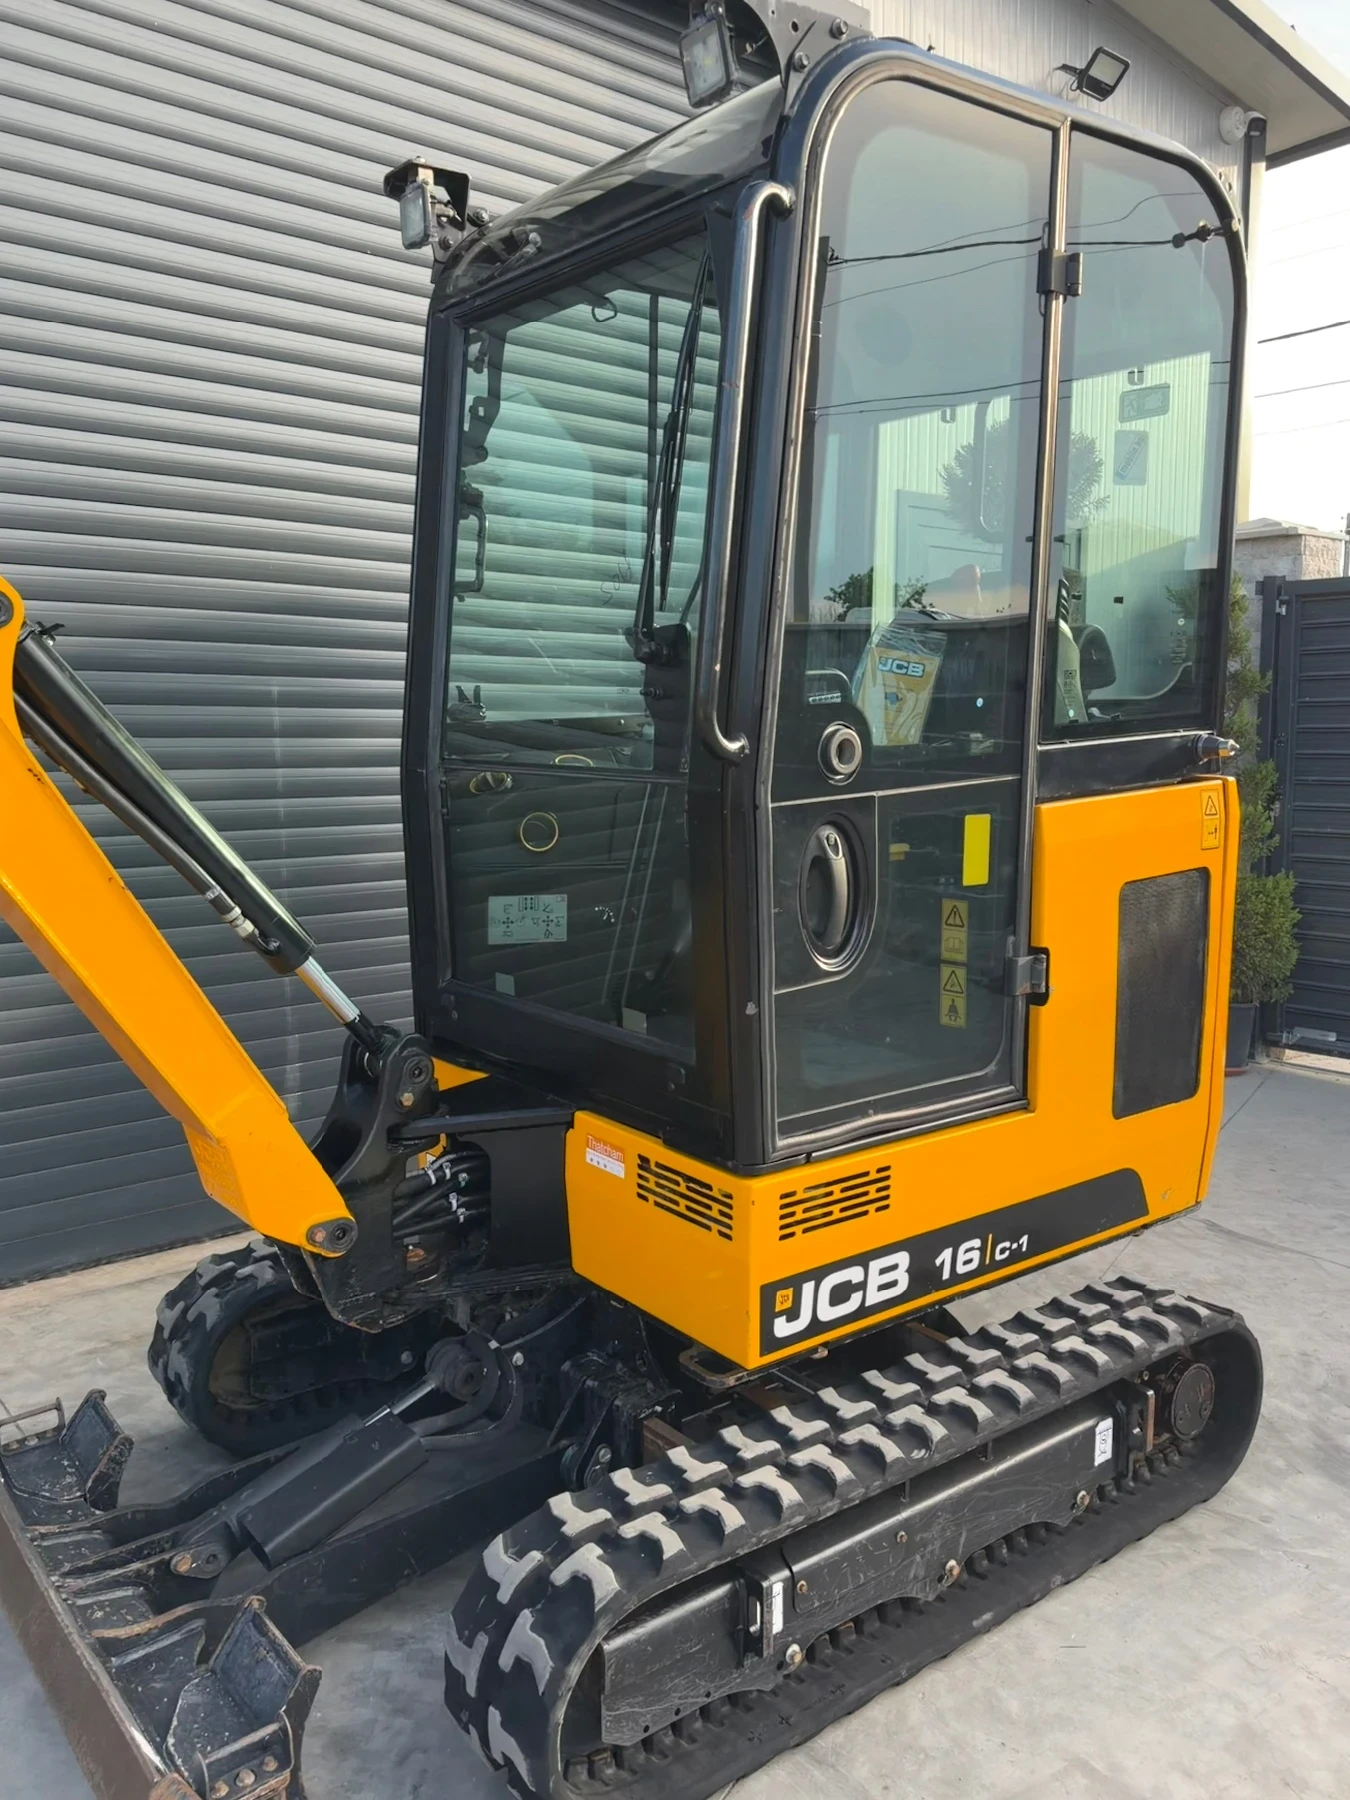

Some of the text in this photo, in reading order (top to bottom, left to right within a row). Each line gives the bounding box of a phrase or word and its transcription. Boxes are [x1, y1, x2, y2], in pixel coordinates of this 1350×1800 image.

[879, 657, 924, 677] JCB
[587, 1134, 624, 1162] Thatcham
[774, 1250, 910, 1339] JCB
[935, 1237, 981, 1281] 16
